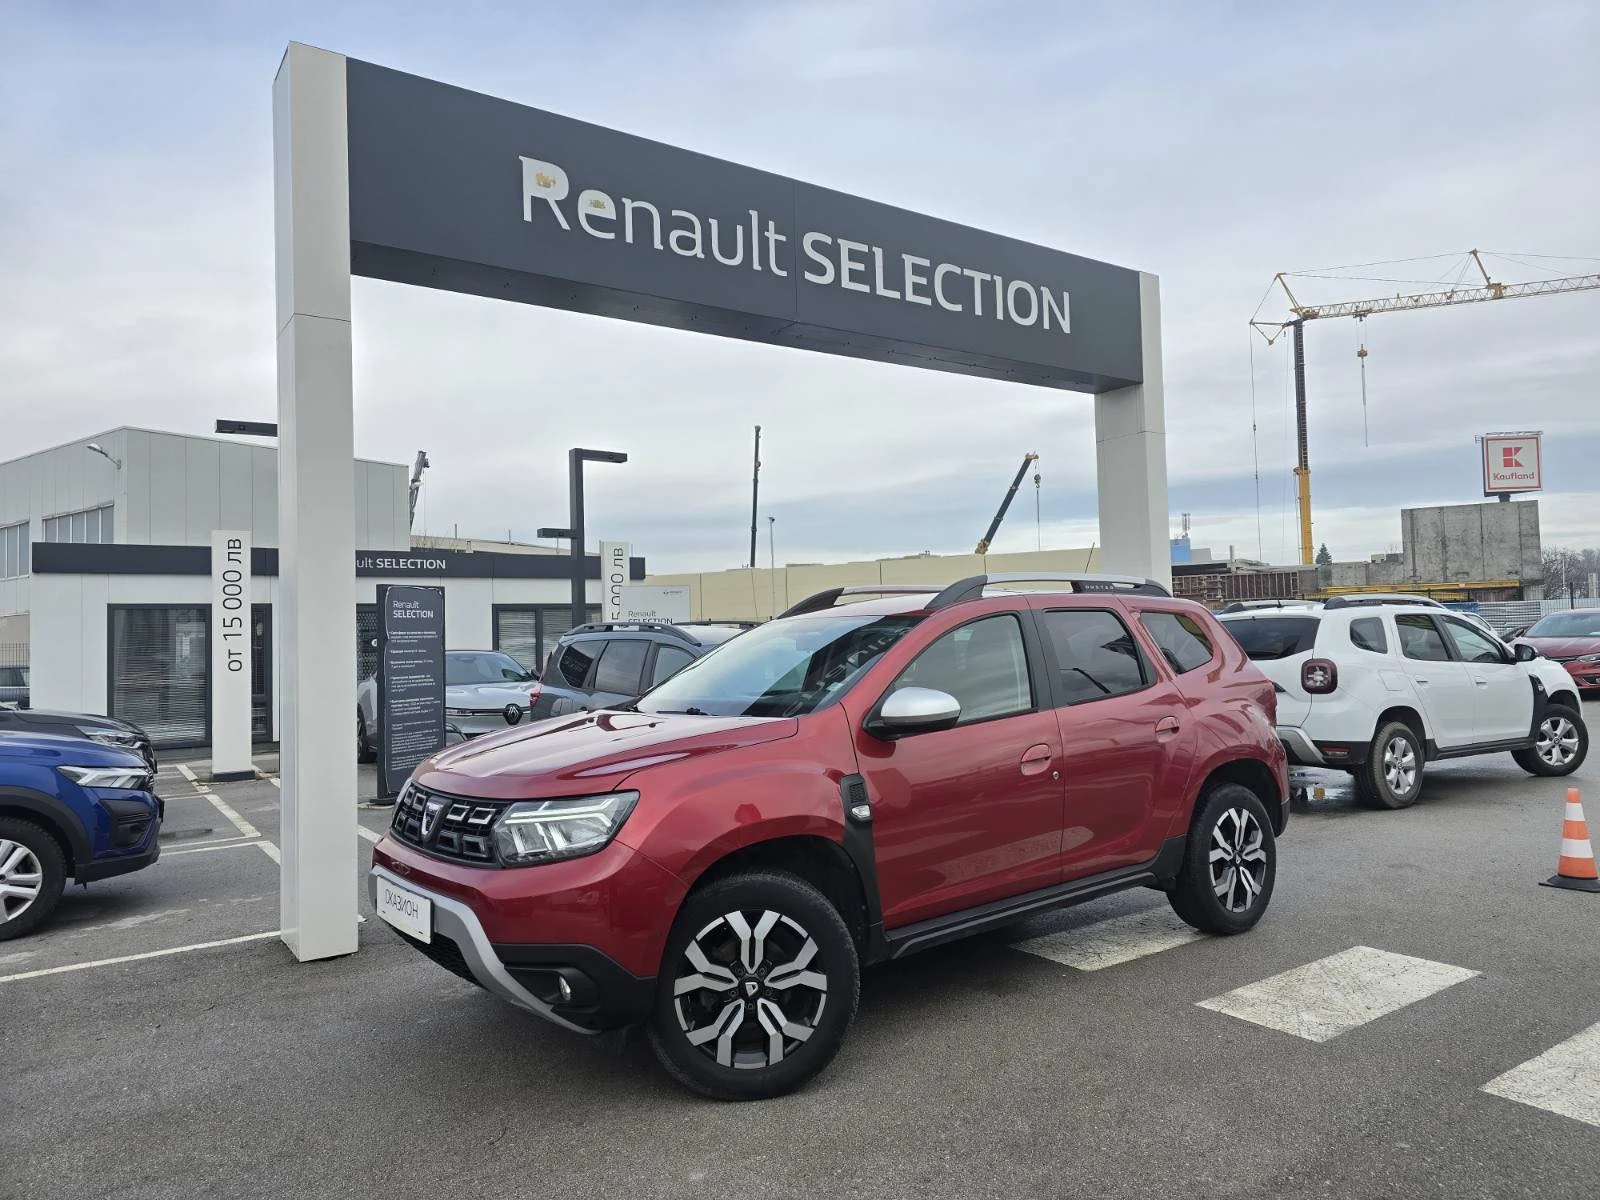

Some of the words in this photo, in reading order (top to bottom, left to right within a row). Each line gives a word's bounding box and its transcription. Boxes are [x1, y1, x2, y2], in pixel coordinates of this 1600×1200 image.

[518, 155, 788, 277] Renault
[802, 231, 1071, 334] SELECTION
[1493, 472, 1535, 481] Kaufland
[376, 559, 446, 569] SELECTION
[222, 570, 242, 610] 000
[392, 600, 420, 609] Renault
[393, 610, 434, 618] SELECTION
[223, 617, 242, 641] 15
[228, 649, 242, 672] от
